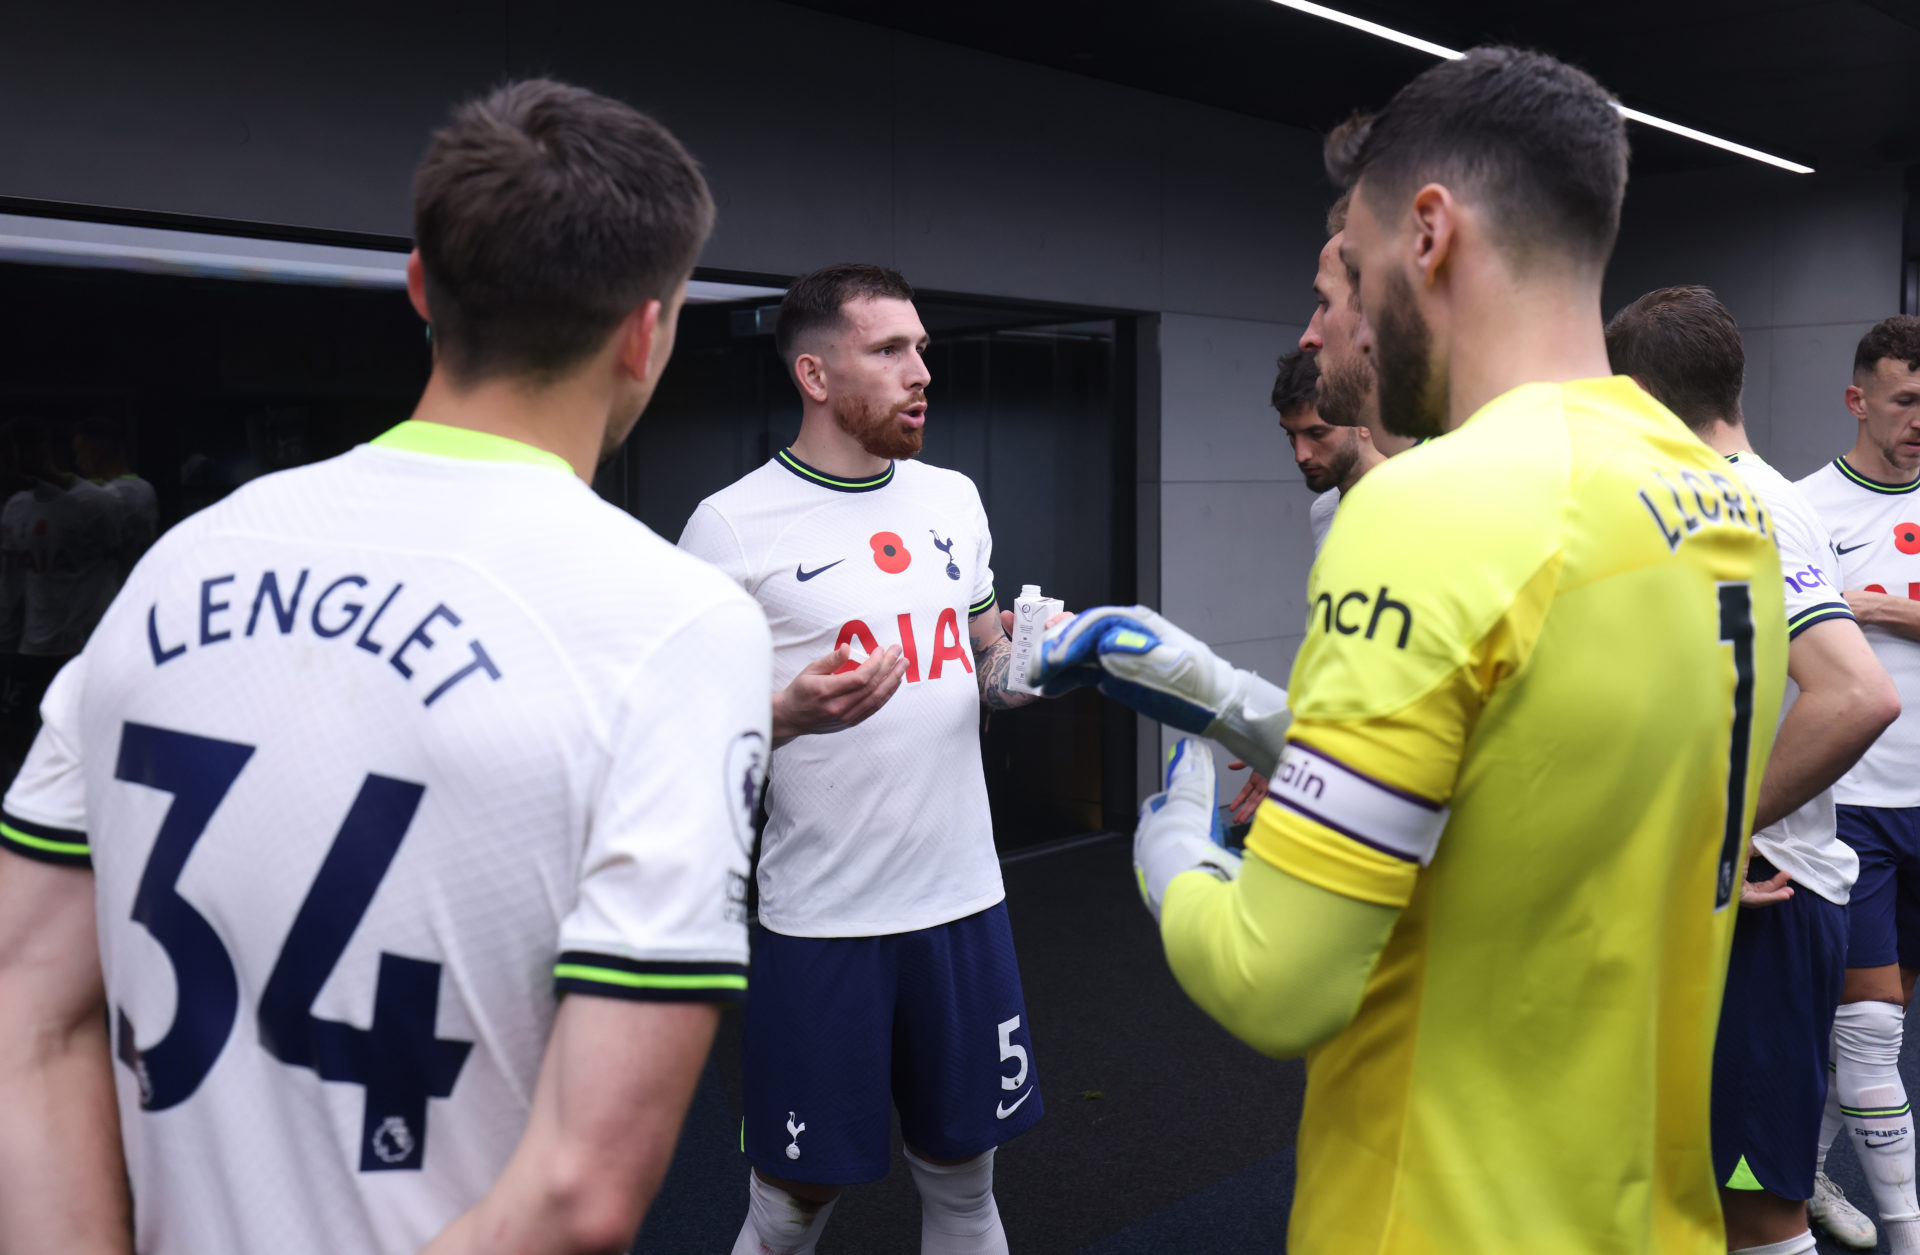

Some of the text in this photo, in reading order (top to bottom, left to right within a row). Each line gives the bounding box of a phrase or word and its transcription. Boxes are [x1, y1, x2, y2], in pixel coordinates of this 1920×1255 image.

[147, 568, 501, 707] LENGLET
[1716, 581, 1754, 912] 1
[115, 720, 474, 1172] 34
[998, 1014, 1028, 1091] 5
[1855, 1127, 1908, 1138] SPURS
